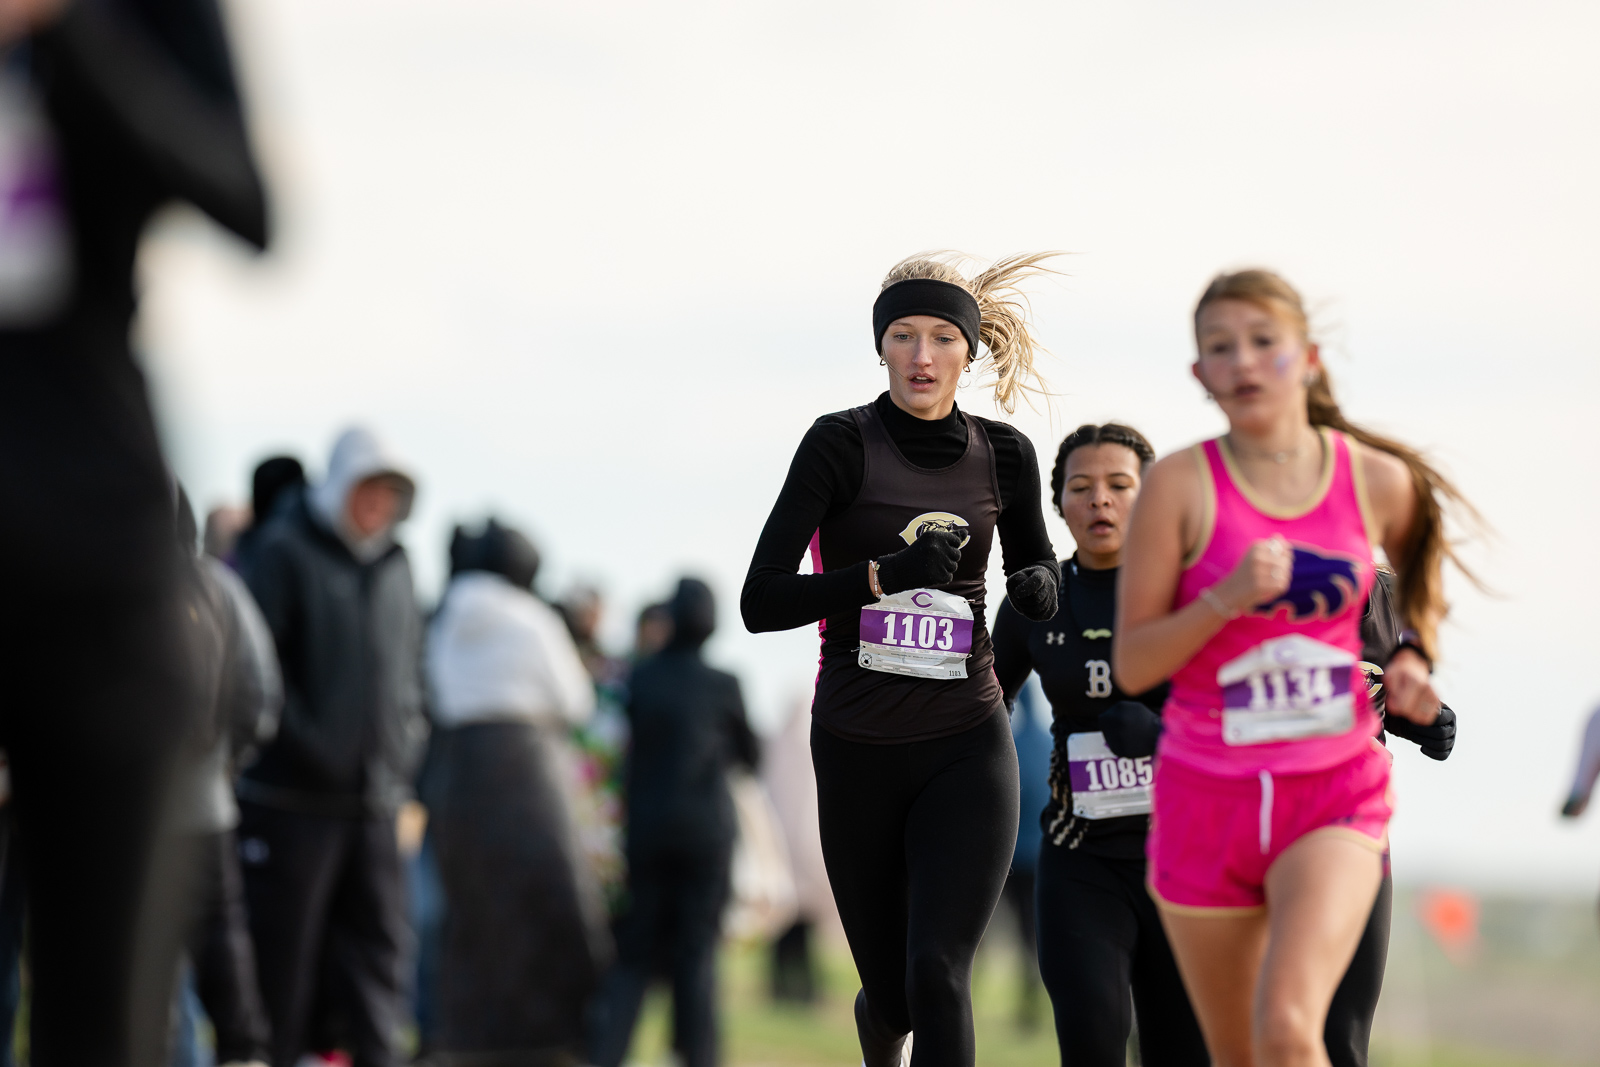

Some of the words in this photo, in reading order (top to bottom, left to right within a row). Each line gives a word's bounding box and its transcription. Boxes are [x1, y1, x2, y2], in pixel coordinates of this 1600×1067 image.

[911, 592, 933, 608] C
[882, 613, 954, 650] 1103
[1085, 660, 1112, 698] B
[1247, 668, 1335, 711] 1134
[1085, 757, 1153, 791] 1085
